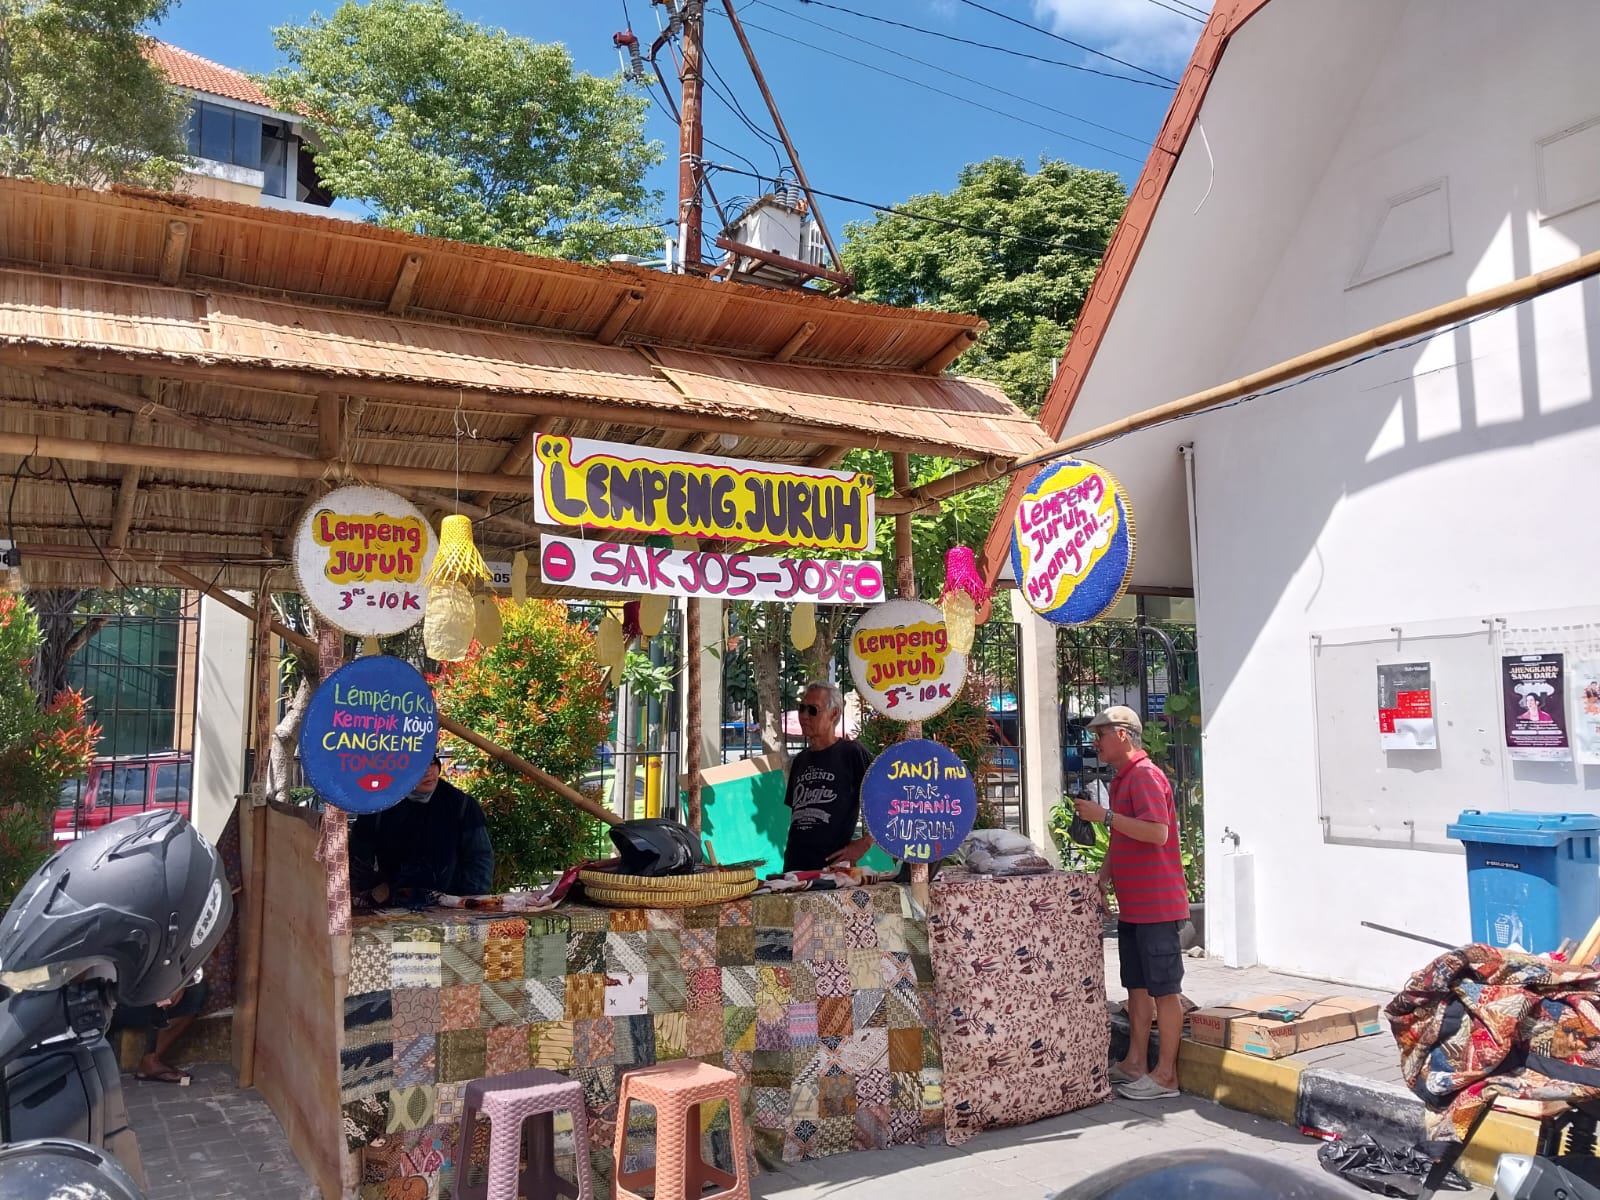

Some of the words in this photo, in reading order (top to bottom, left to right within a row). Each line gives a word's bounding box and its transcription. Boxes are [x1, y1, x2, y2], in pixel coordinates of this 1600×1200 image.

[320, 515, 421, 552] Lempeng
[330, 548, 413, 575] Juruh
[591, 543, 675, 589] SAK
[858, 629, 948, 655] Lempeng
[871, 651, 936, 684] Juruh
[333, 710, 399, 736] Kemripik
[322, 731, 424, 752] CANGKEME
[337, 753, 410, 772] TONGGO
[903, 783, 940, 800] TAK
[885, 816, 955, 841] JURUH
